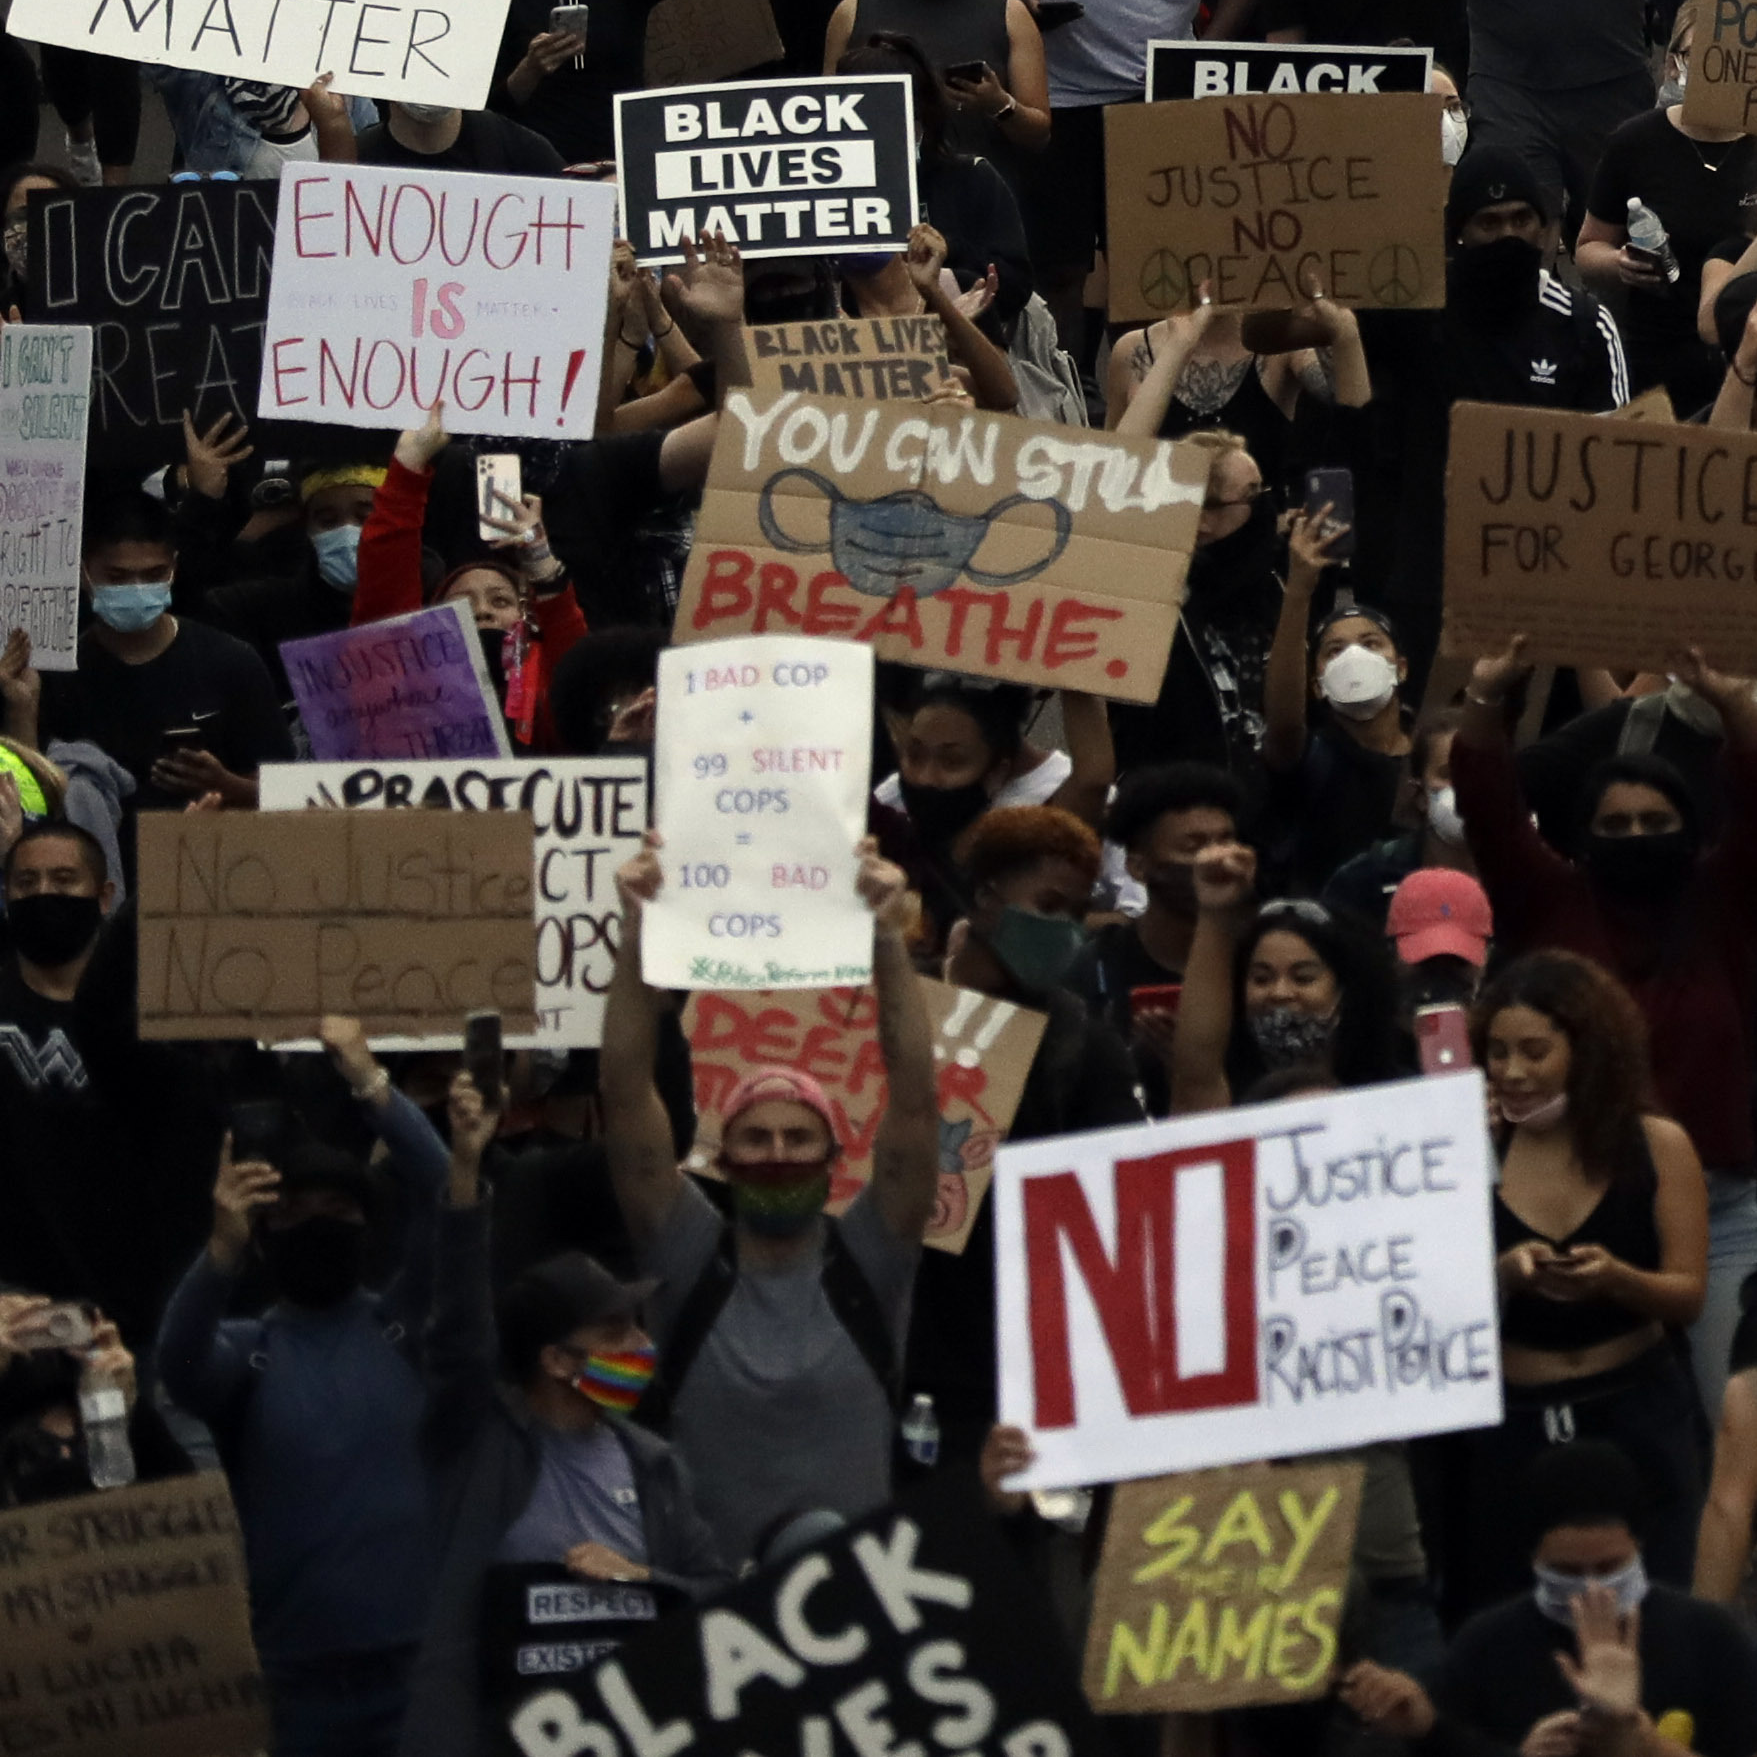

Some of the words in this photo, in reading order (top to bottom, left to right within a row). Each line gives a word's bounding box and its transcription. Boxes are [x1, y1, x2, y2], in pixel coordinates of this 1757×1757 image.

[663, 94, 869, 143] BLACK
[691, 147, 845, 192] LIVES
[291, 177, 586, 270] ENOUGH
[646, 198, 892, 250] MATTER
[411, 278, 467, 339] IS
[270, 336, 586, 428] ENOUGH!
[727, 390, 879, 476] YOU
[885, 422, 1002, 486] CAN
[1015, 434, 1208, 514] STILL
[1479, 522, 1572, 579] FOR
[691, 548, 1132, 681] BREATHE.
[1020, 1136, 1260, 1430] NO
[1265, 1217, 1420, 1302] PEACE
[1134, 1487, 1341, 1585] SAY
[1102, 1589, 1341, 1694] NAMES
